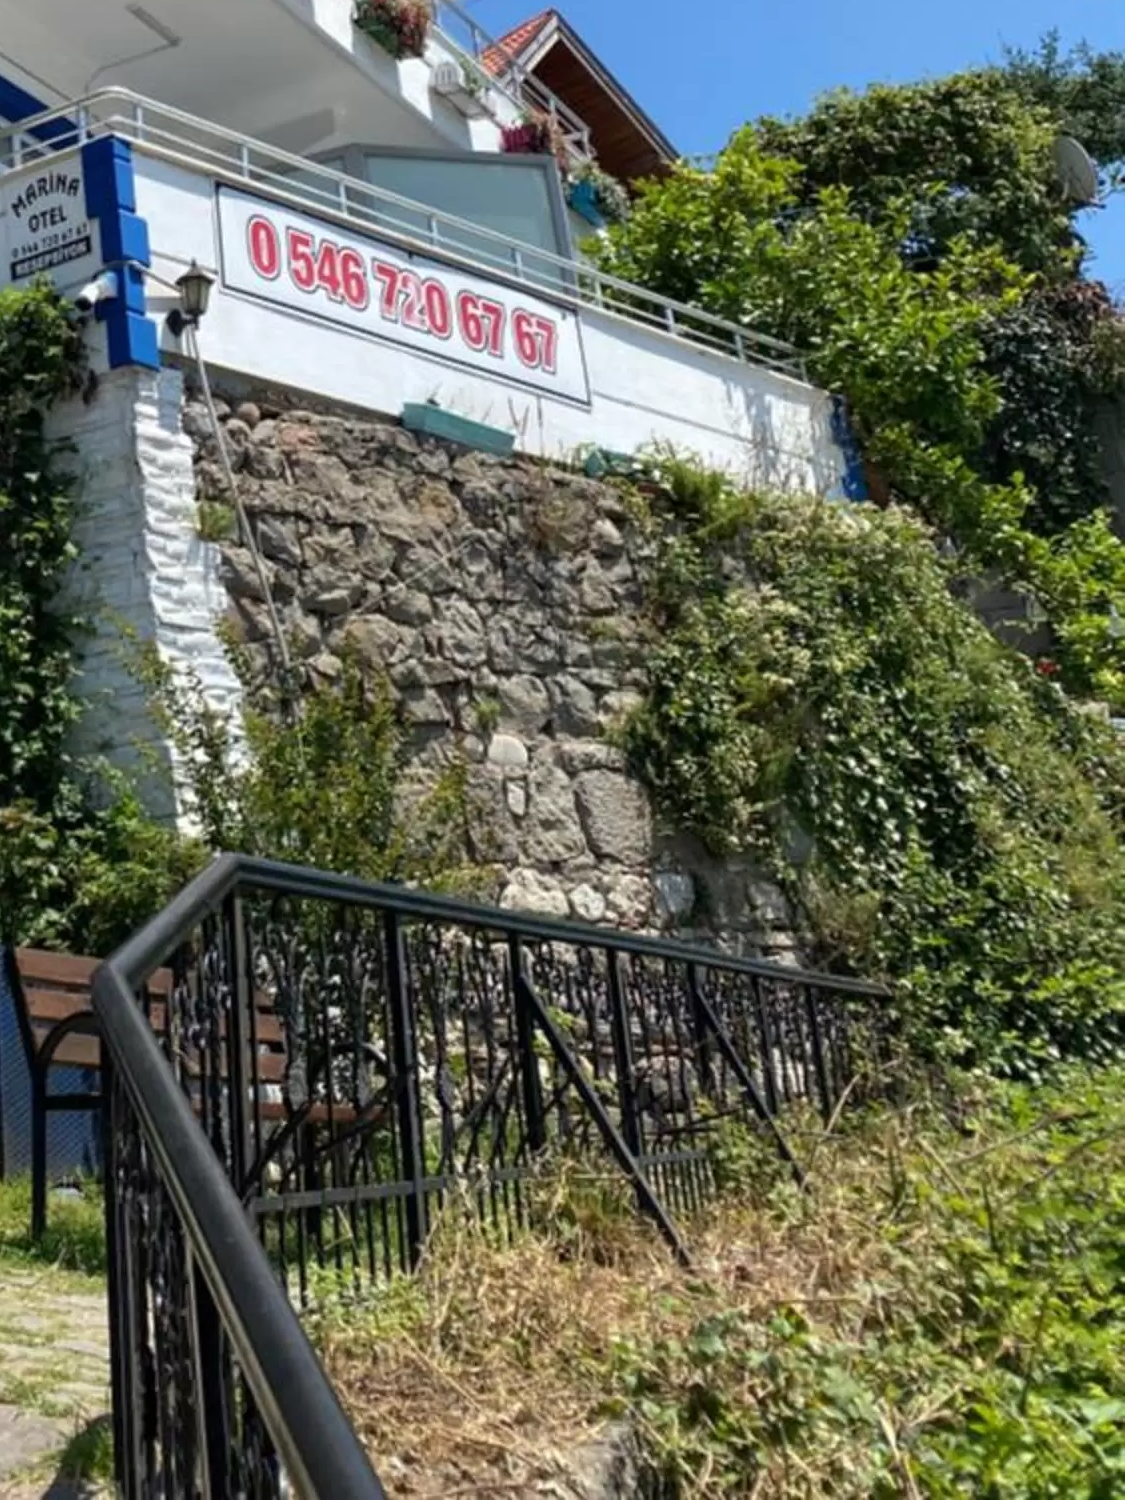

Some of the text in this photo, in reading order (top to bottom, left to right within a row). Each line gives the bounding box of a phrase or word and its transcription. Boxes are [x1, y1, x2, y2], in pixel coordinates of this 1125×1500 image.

[28, 205, 67, 233] OTEL
[246, 214, 558, 375] 0 546 720 67 67
